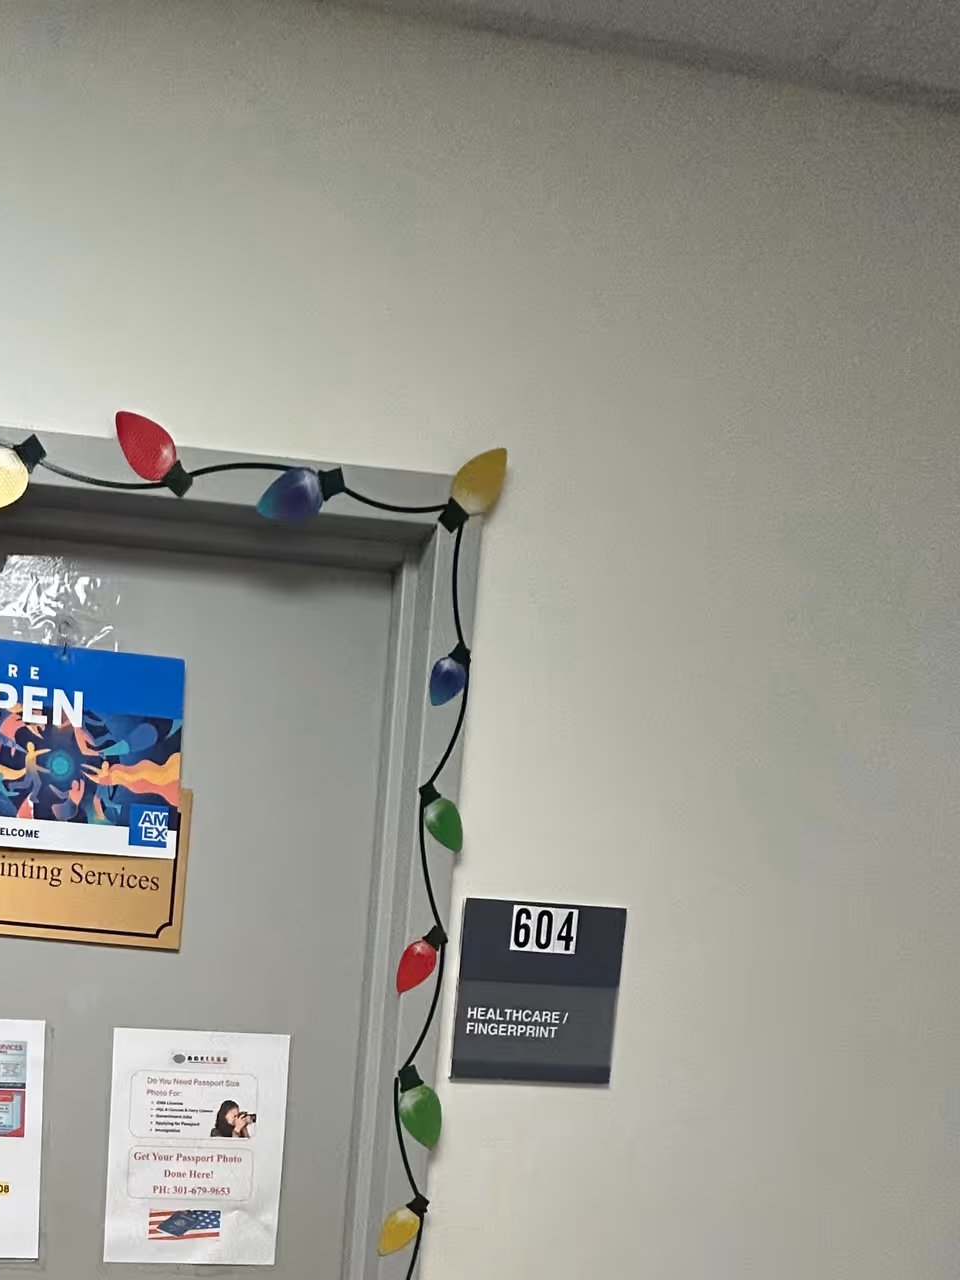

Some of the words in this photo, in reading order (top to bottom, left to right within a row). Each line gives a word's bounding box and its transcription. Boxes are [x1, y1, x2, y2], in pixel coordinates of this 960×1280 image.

[70, 863, 160, 891] Services
[513, 908, 574, 951] 604
[466, 1022, 558, 1038] FINGERPRINT
[158, 1077, 172, 1085] You
[193, 1079, 224, 1087] Passport
[147, 1089, 167, 1097] Photo
[134, 1152, 149, 1161] Get
[152, 1153, 174, 1162] Your
[176, 1154, 214, 1164] Passport
[217, 1154, 242, 1164] Photo
[164, 1170, 187, 1178] Done
[189, 1170, 214, 1179] Here!
[153, 1186, 170, 1194] PH:
[172, 1186, 231, 1195] 301-679-9653
